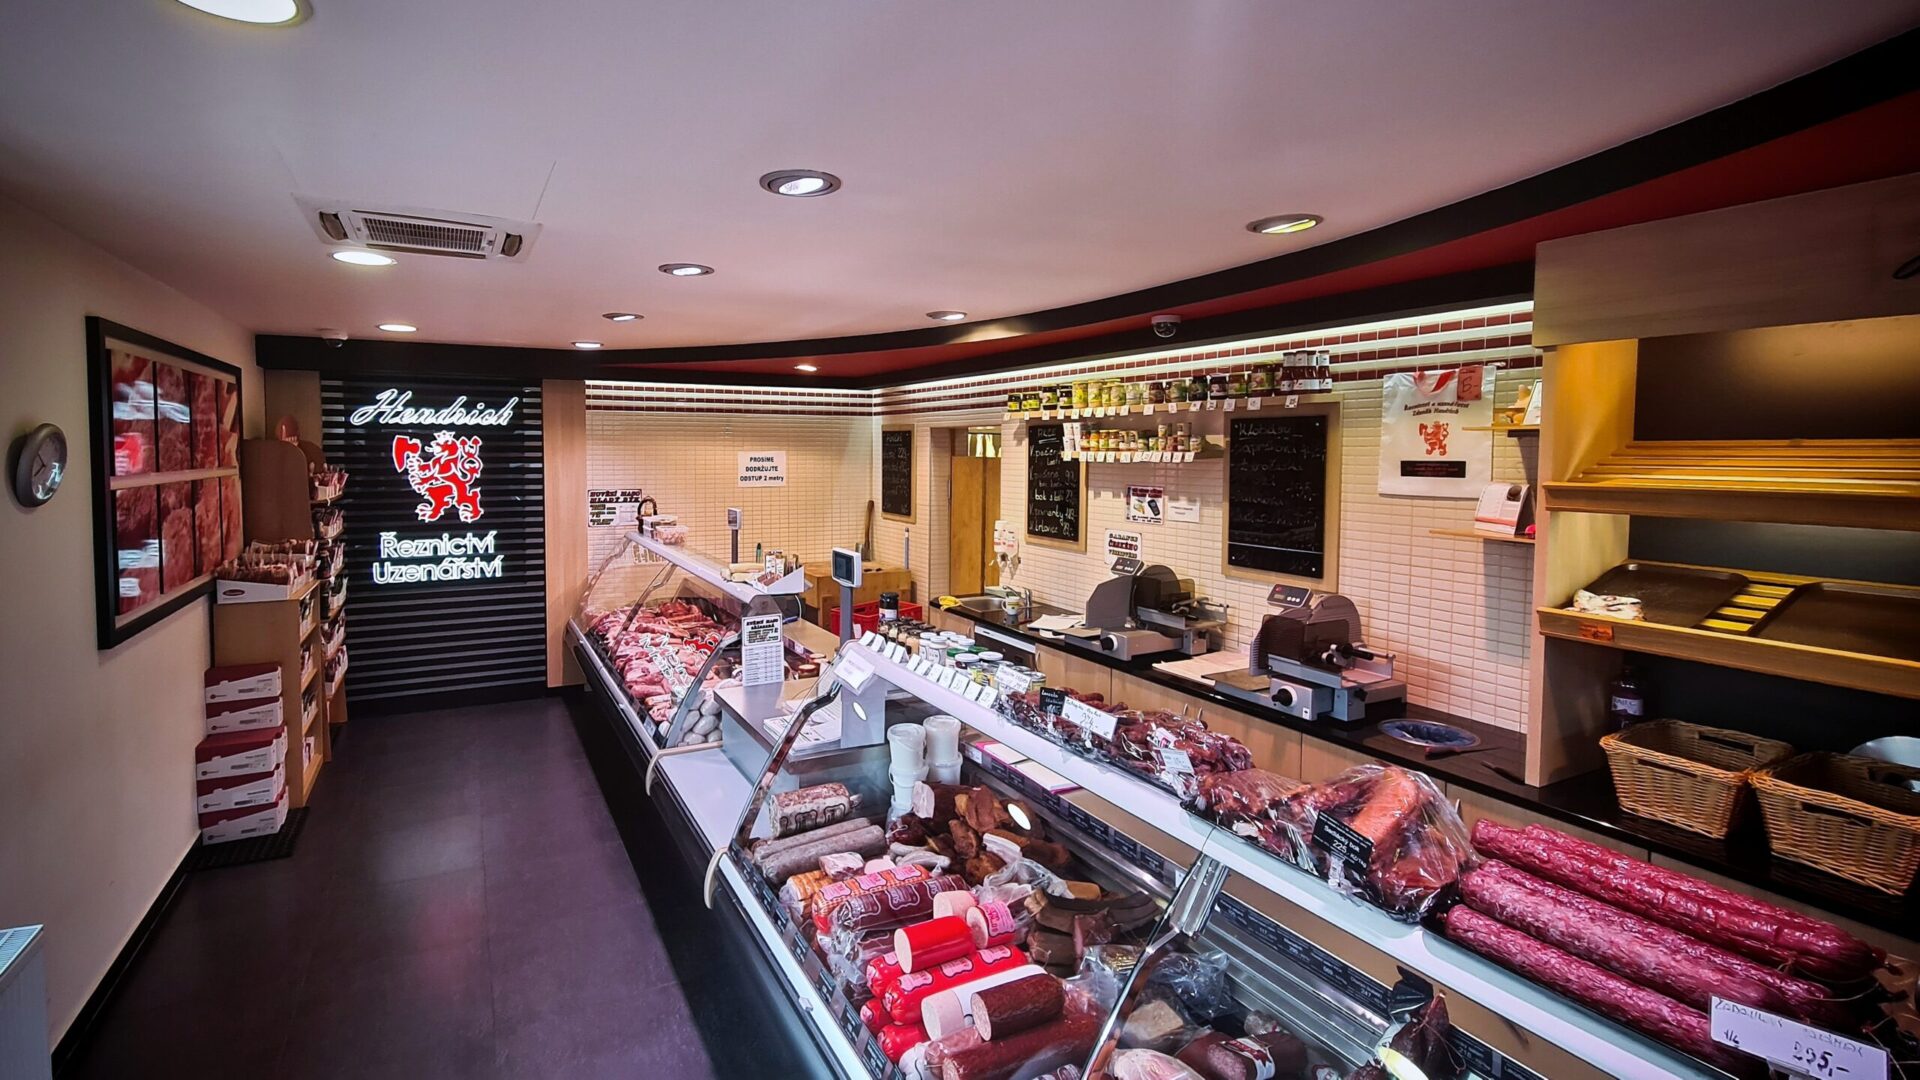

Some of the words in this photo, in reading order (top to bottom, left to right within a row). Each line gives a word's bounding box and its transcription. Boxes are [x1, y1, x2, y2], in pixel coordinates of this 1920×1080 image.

[351, 388, 519, 426] Hendrich
[745, 464, 779, 472] DODRŽUJTE
[379, 531, 497, 558] Řeznictví
[373, 555, 504, 583] Uzenářství
